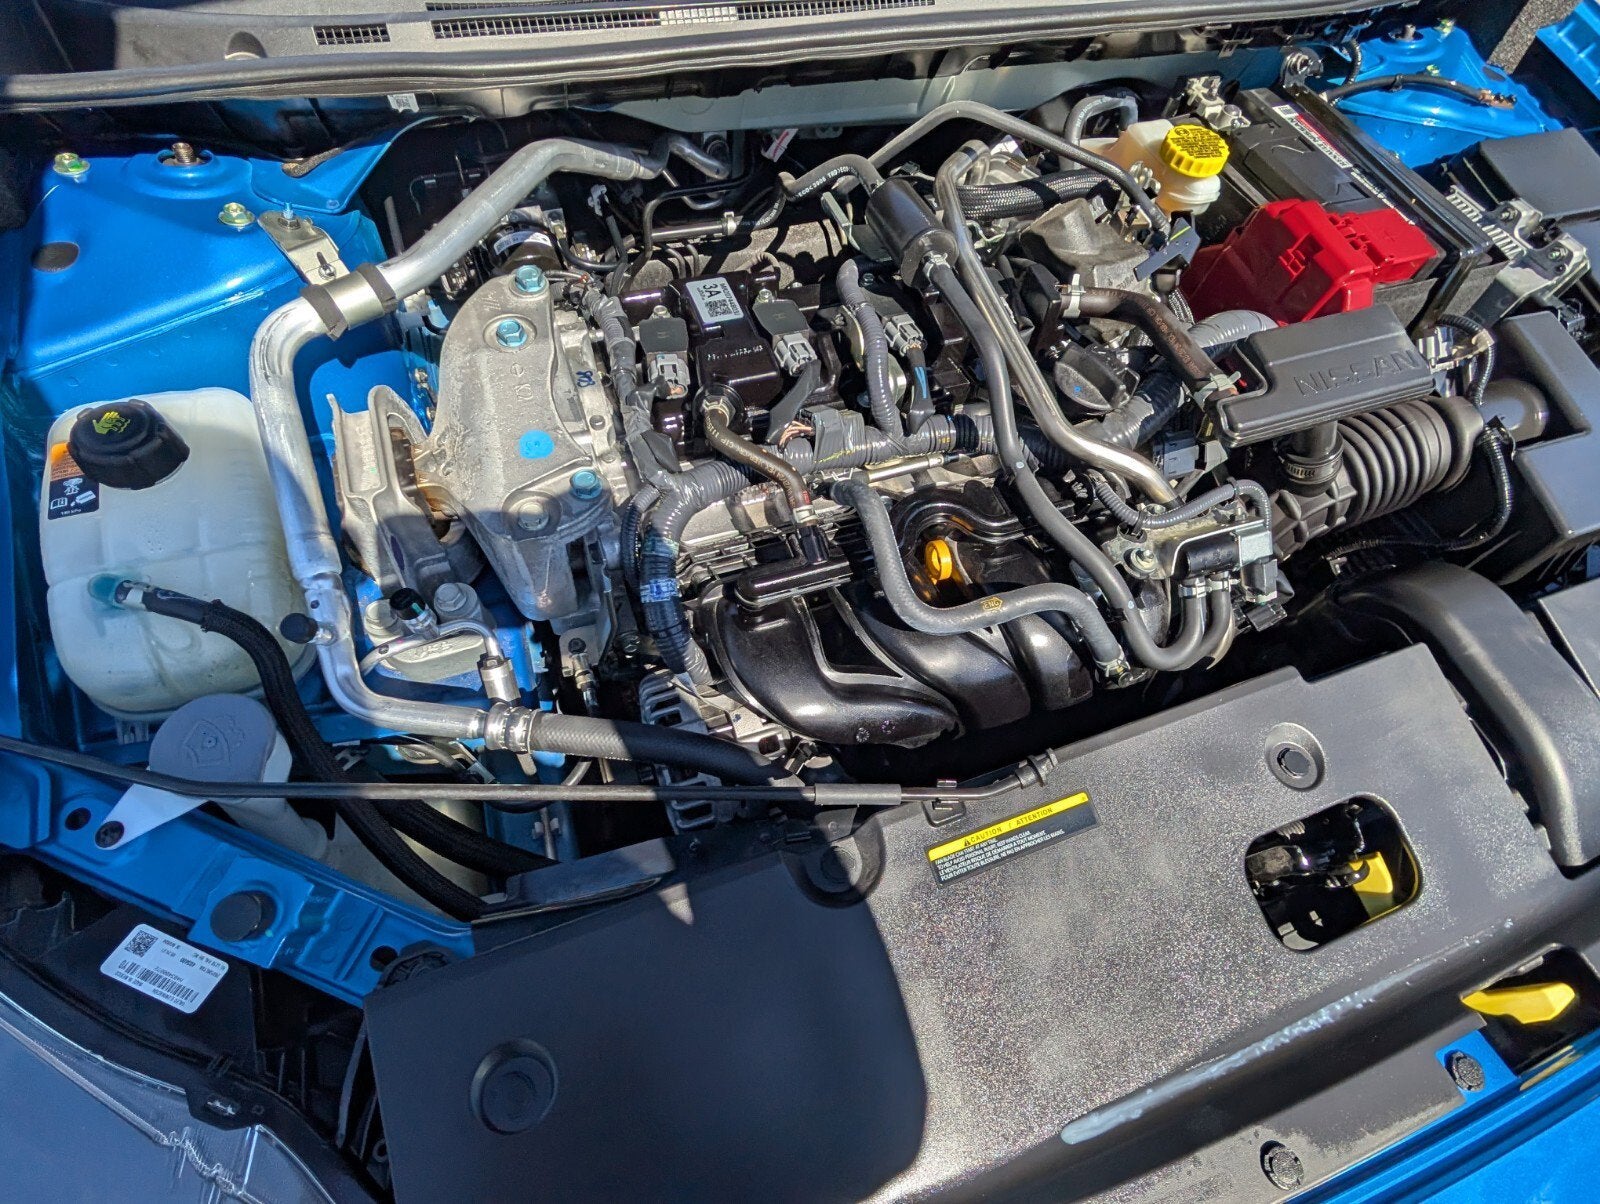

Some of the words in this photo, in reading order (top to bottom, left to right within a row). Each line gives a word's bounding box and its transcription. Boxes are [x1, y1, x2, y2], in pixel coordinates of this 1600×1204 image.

[703, 284, 721, 298] 3A
[1293, 350, 1419, 396] NISSAN
[970, 827, 1003, 843] CAUTION
[1016, 807, 1053, 826] ATTENTION
